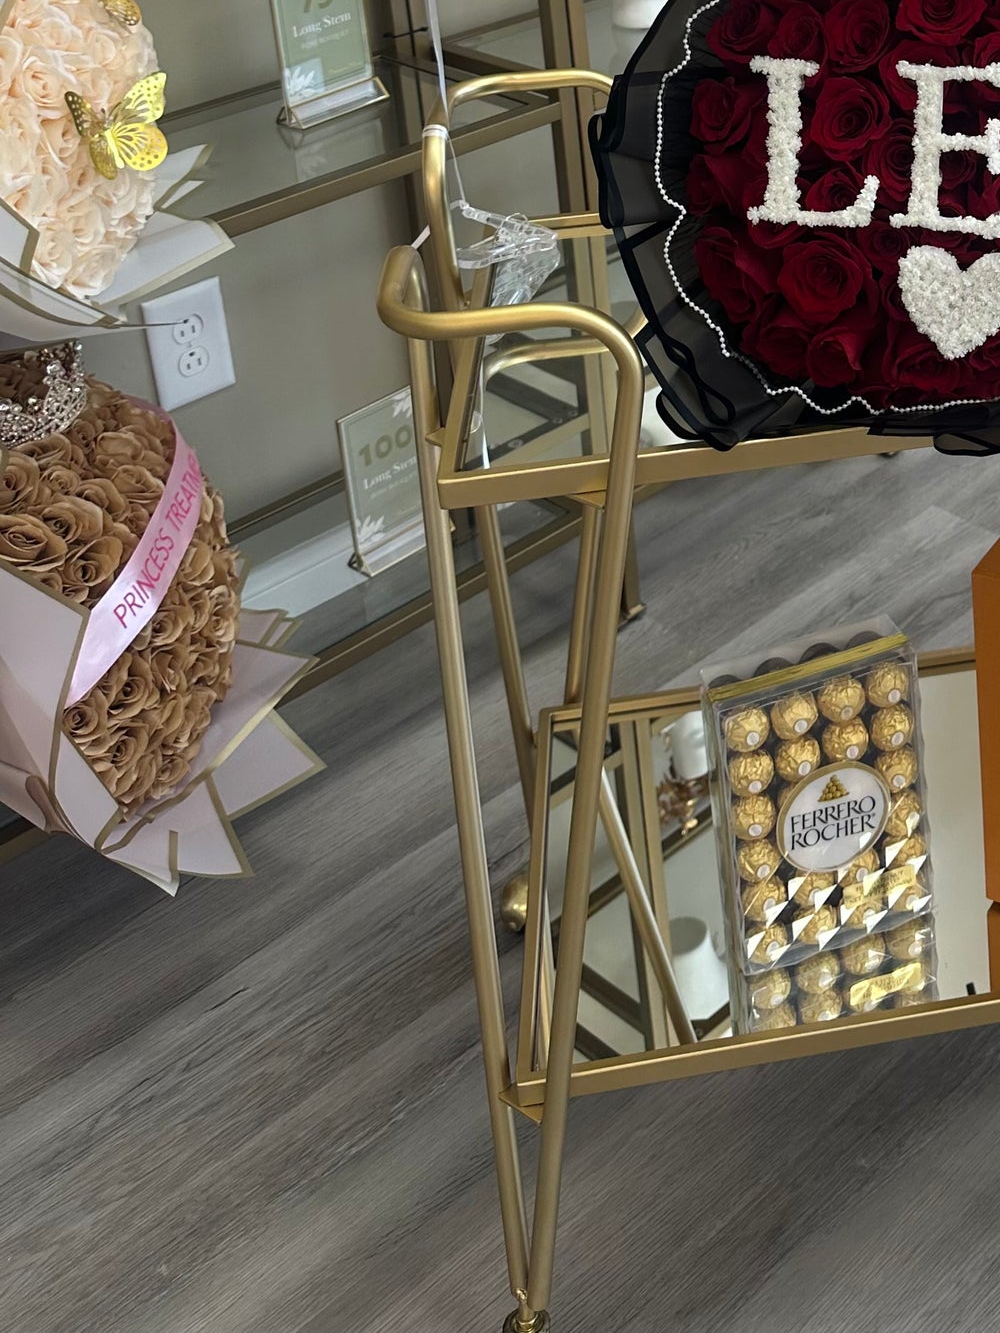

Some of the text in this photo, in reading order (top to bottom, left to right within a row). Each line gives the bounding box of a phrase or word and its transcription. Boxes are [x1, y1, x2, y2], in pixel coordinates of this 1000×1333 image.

[292, 12, 352, 38] Long Stem
[359, 423, 413, 467] 100
[363, 468, 393, 491] Long
[113, 528, 175, 630] PRINCESS
[791, 795, 876, 833] FERRERO
